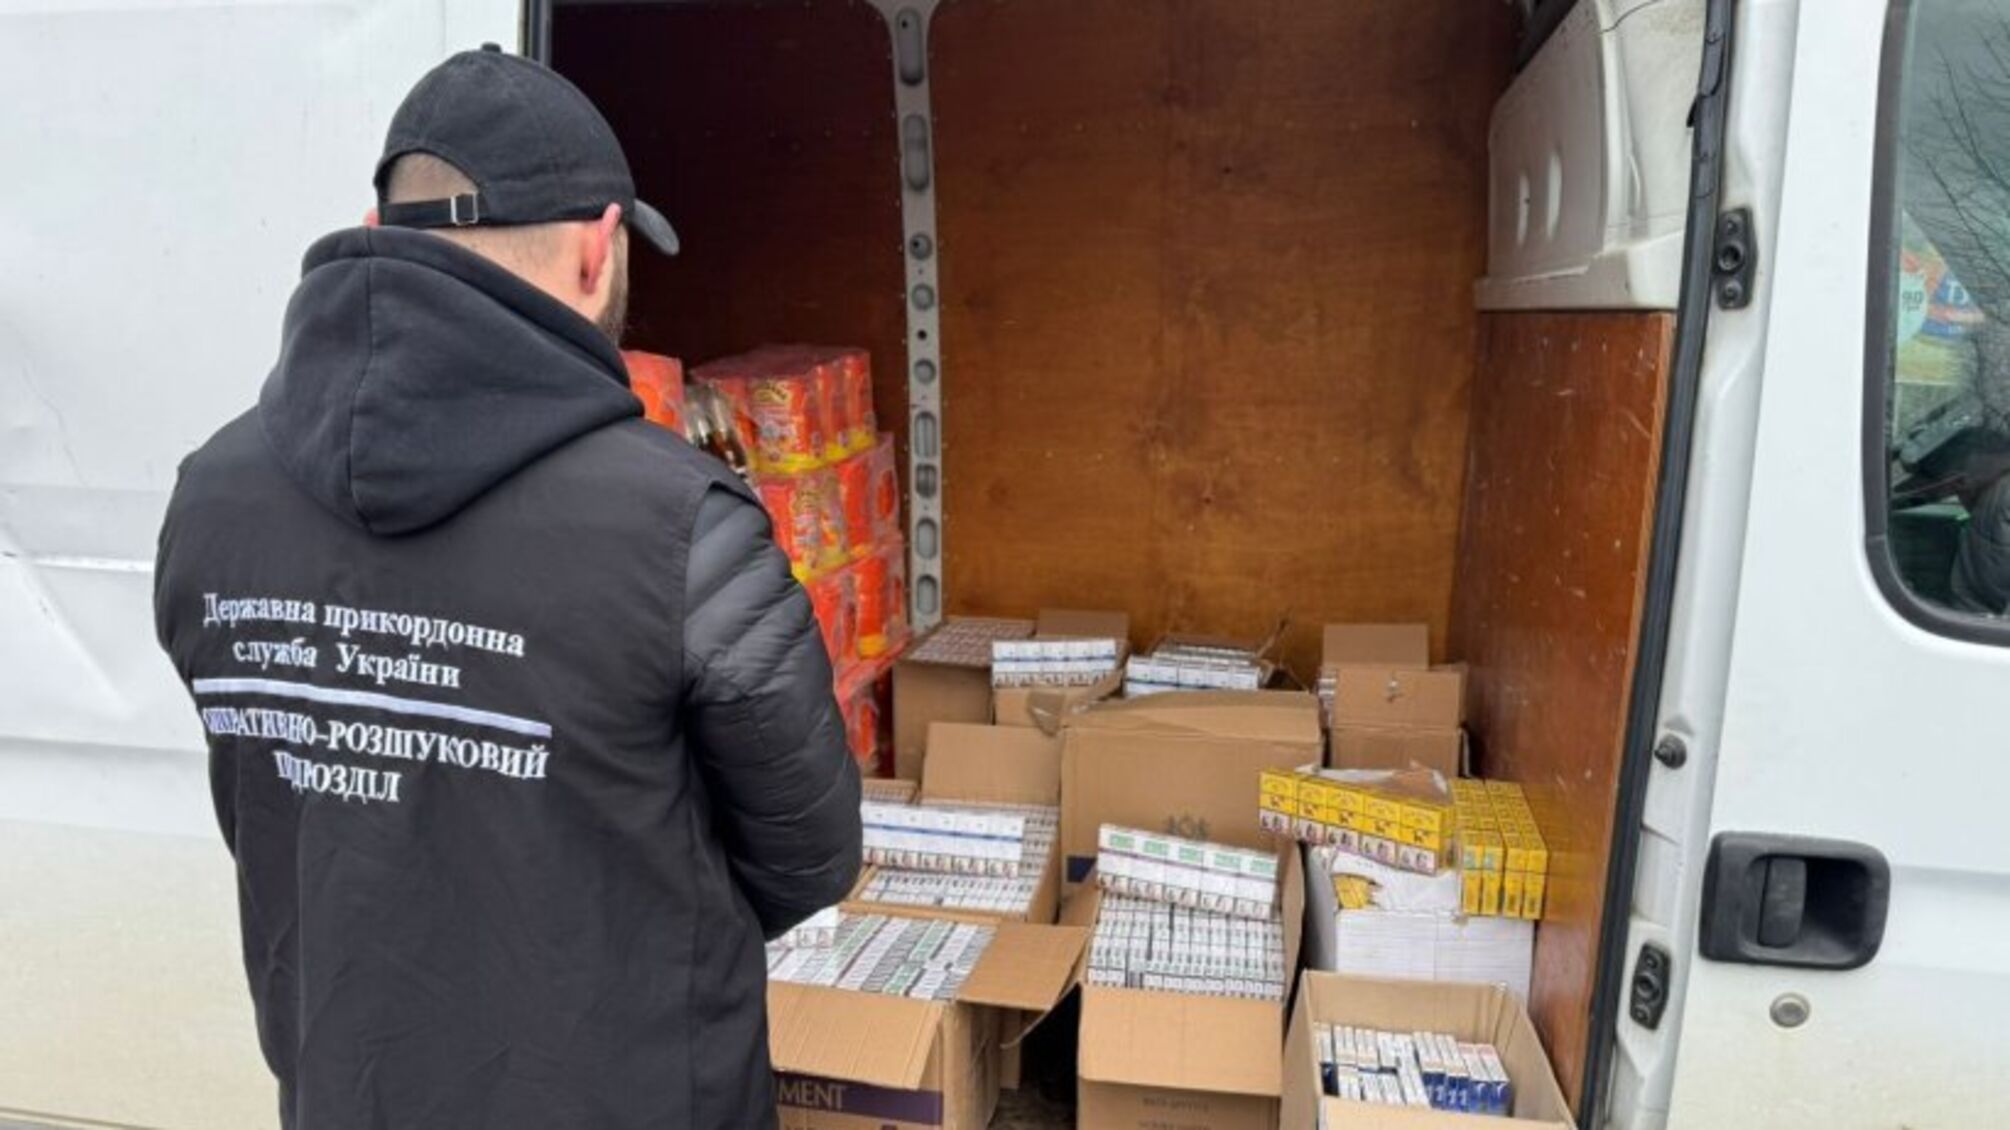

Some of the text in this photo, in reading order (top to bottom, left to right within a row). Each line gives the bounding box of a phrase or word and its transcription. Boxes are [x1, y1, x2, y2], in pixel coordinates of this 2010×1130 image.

[203, 593, 525, 657] Державна прикордонна
[233, 638, 461, 688] служба України
